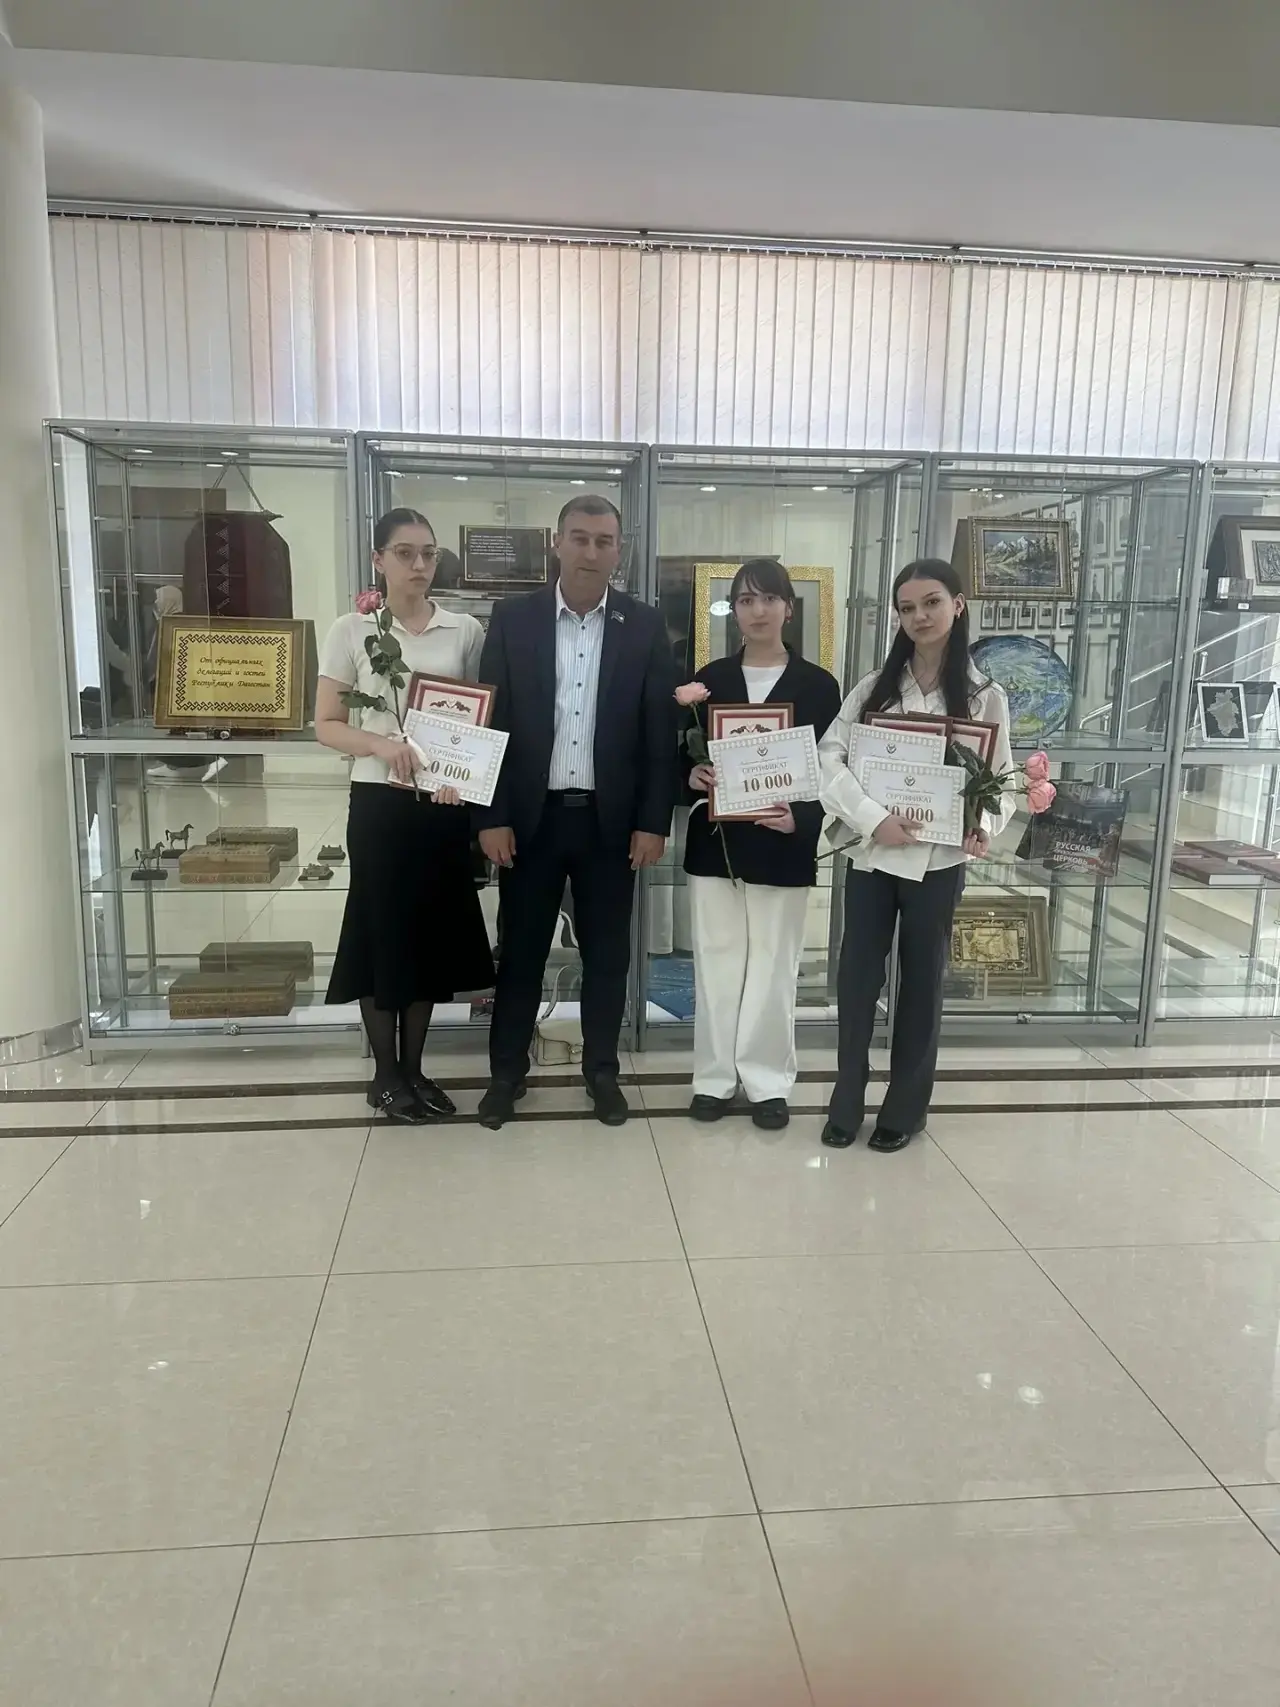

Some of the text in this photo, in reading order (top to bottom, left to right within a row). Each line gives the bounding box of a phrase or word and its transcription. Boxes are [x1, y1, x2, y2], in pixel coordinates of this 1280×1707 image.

[215, 656, 264, 667] официальных
[196, 668, 232, 677] делегаций
[191, 680, 271, 689] Республики Дагестан
[428, 747, 472, 763] СЕРТИФИКАТ
[444, 764, 471, 782] 000
[742, 761, 788, 774] СЕРТИФИКАТ
[742, 772, 793, 793] 10 000
[885, 792, 932, 804] СЕРТИФИКАТ
[905, 806, 934, 823] 000
[1055, 841, 1091, 853] РУССКАЯ
[1053, 854, 1088, 865] ЦЕРКОВЬ
